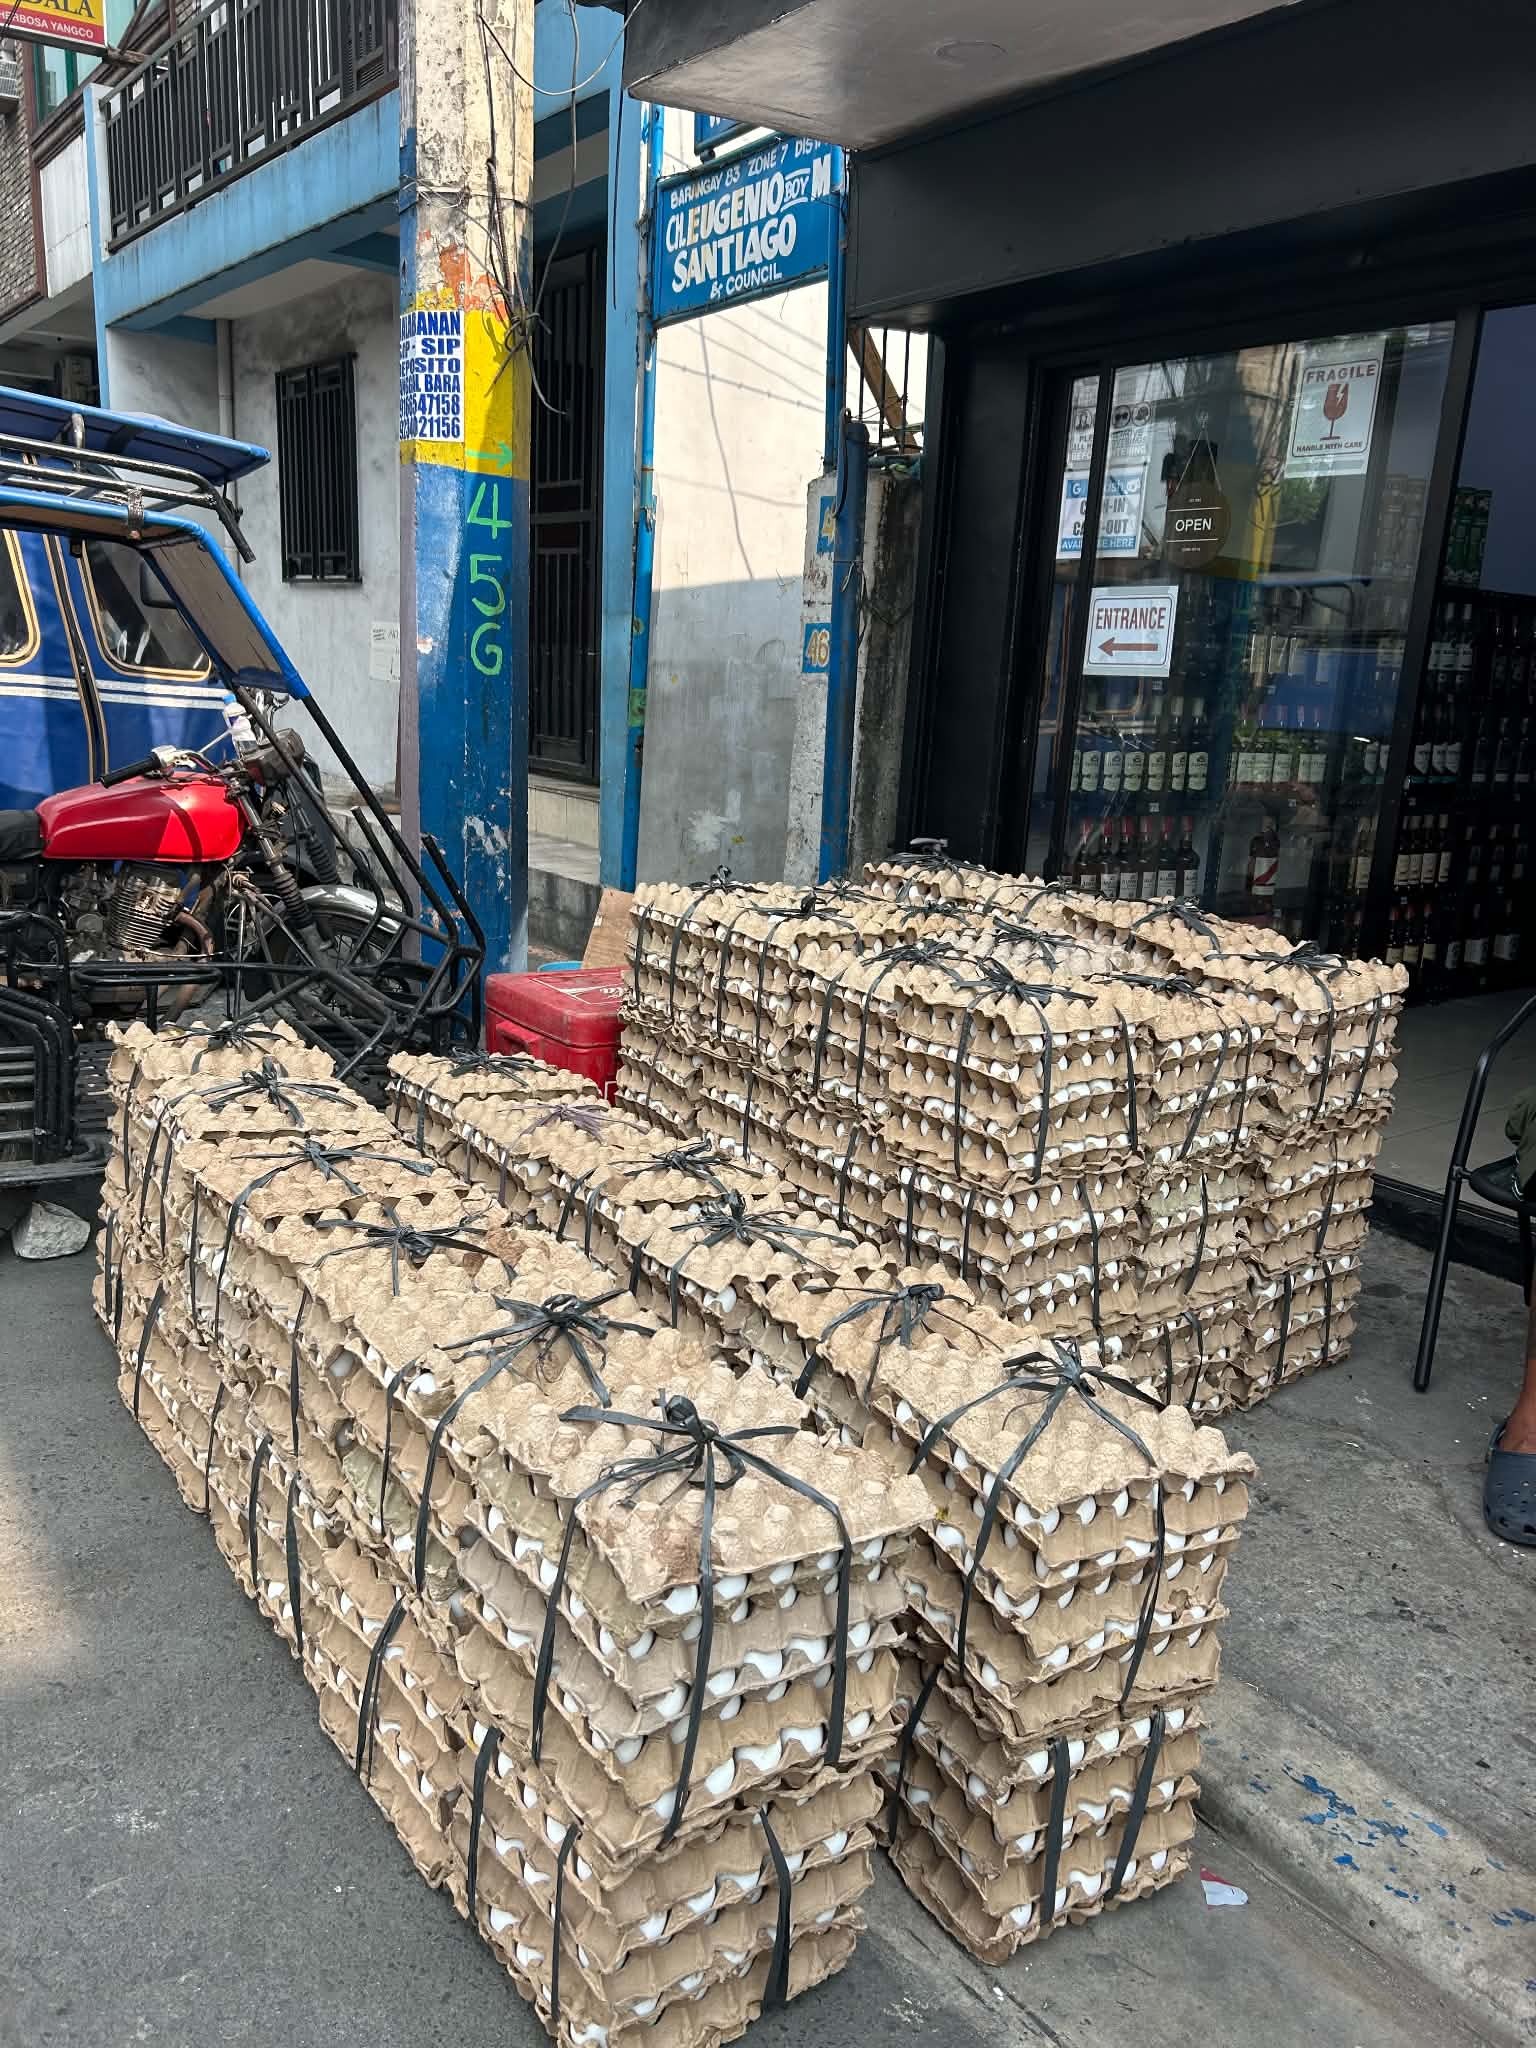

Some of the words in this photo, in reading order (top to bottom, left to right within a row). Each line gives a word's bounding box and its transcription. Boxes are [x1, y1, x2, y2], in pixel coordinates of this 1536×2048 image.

[50, 22, 94, 39] YANGCO
[670, 172, 722, 210] BARANGAY
[725, 166, 741, 188] 83
[748, 151, 777, 178] ZONE
[780, 143, 789, 164] 7
[784, 176, 810, 199] BOY
[671, 213, 797, 293] SANTIAGO
[710, 279, 724, 300] &
[726, 262, 783, 295] COUNCIL
[400, 311, 461, 342] ALABANAN
[421, 338, 461, 356] SIP
[425, 373, 460, 393] BARA
[1306, 364, 1377, 382] FRAGILE
[1175, 518, 1212, 532] OPEN
[1096, 607, 1167, 630] ENTRANCE
[806, 627, 830, 668] 46
